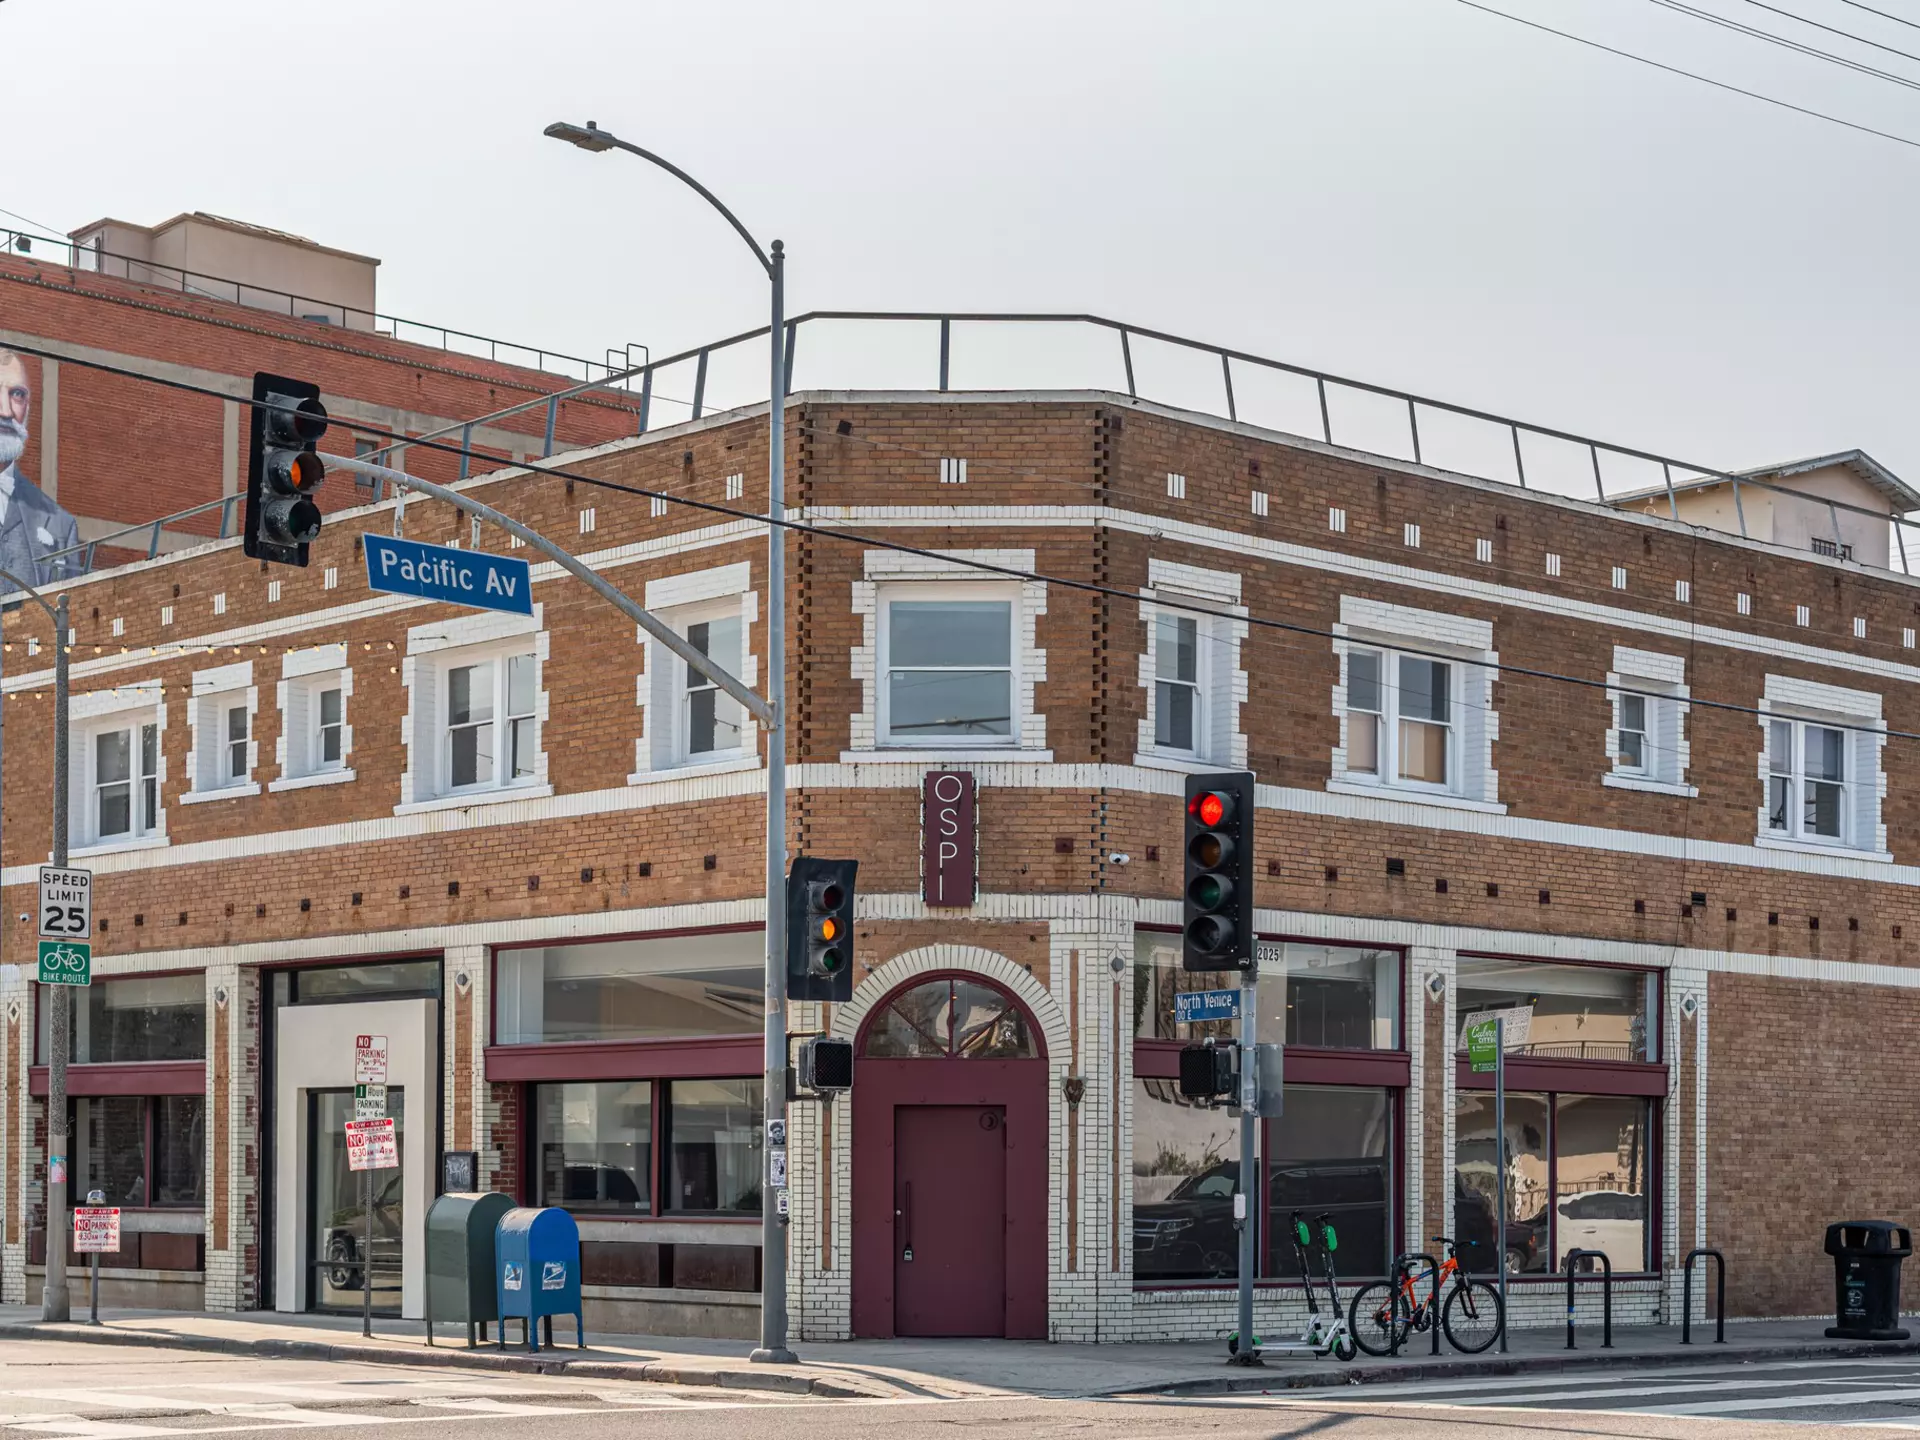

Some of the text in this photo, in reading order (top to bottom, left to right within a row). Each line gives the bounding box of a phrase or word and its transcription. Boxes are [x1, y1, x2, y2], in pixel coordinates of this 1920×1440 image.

[380, 548, 517, 598] Pacific Av
[935, 775, 963, 901] OSPI
[43, 873, 88, 887] SPEED
[48, 889, 84, 902] LIMIT
[44, 905, 86, 933] 25
[1257, 947, 1279, 962] 2025
[43, 972, 86, 983] BIKE ROUTE
[1176, 993, 1232, 1010] North Venice
[1187, 1010, 1192, 1020] E
[358, 1037, 369, 1047] NO
[357, 1049, 386, 1059] PARKING
[360, 1086, 384, 1097] 1 HOUR
[357, 1100, 384, 1109] PARKING
[349, 1132, 393, 1147] NO PARKING
[77, 1220, 118, 1231] NO PARKING
